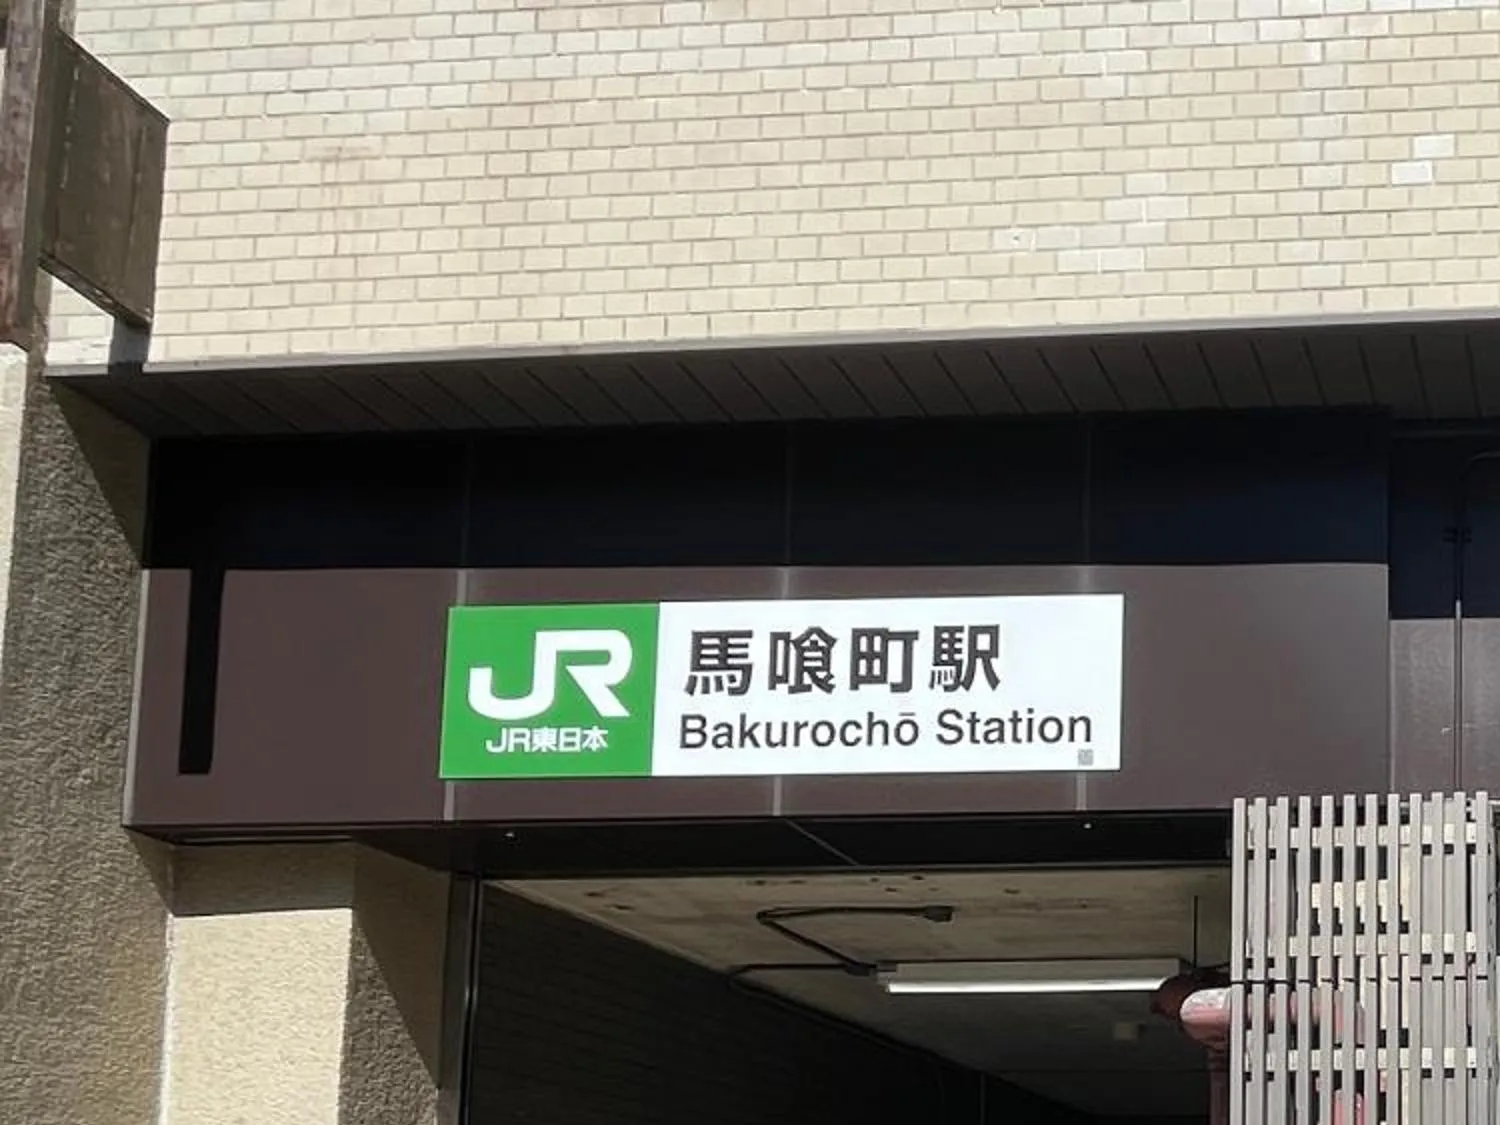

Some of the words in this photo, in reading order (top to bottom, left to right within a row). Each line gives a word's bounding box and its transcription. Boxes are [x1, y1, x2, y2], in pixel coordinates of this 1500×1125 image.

[468, 629, 633, 720] JR
[684, 624, 1001, 696] 馬喰町駅
[485, 725, 609, 753] JR東日本
[680, 711, 920, 749] Bakurochō
[936, 708, 1093, 746] Station
